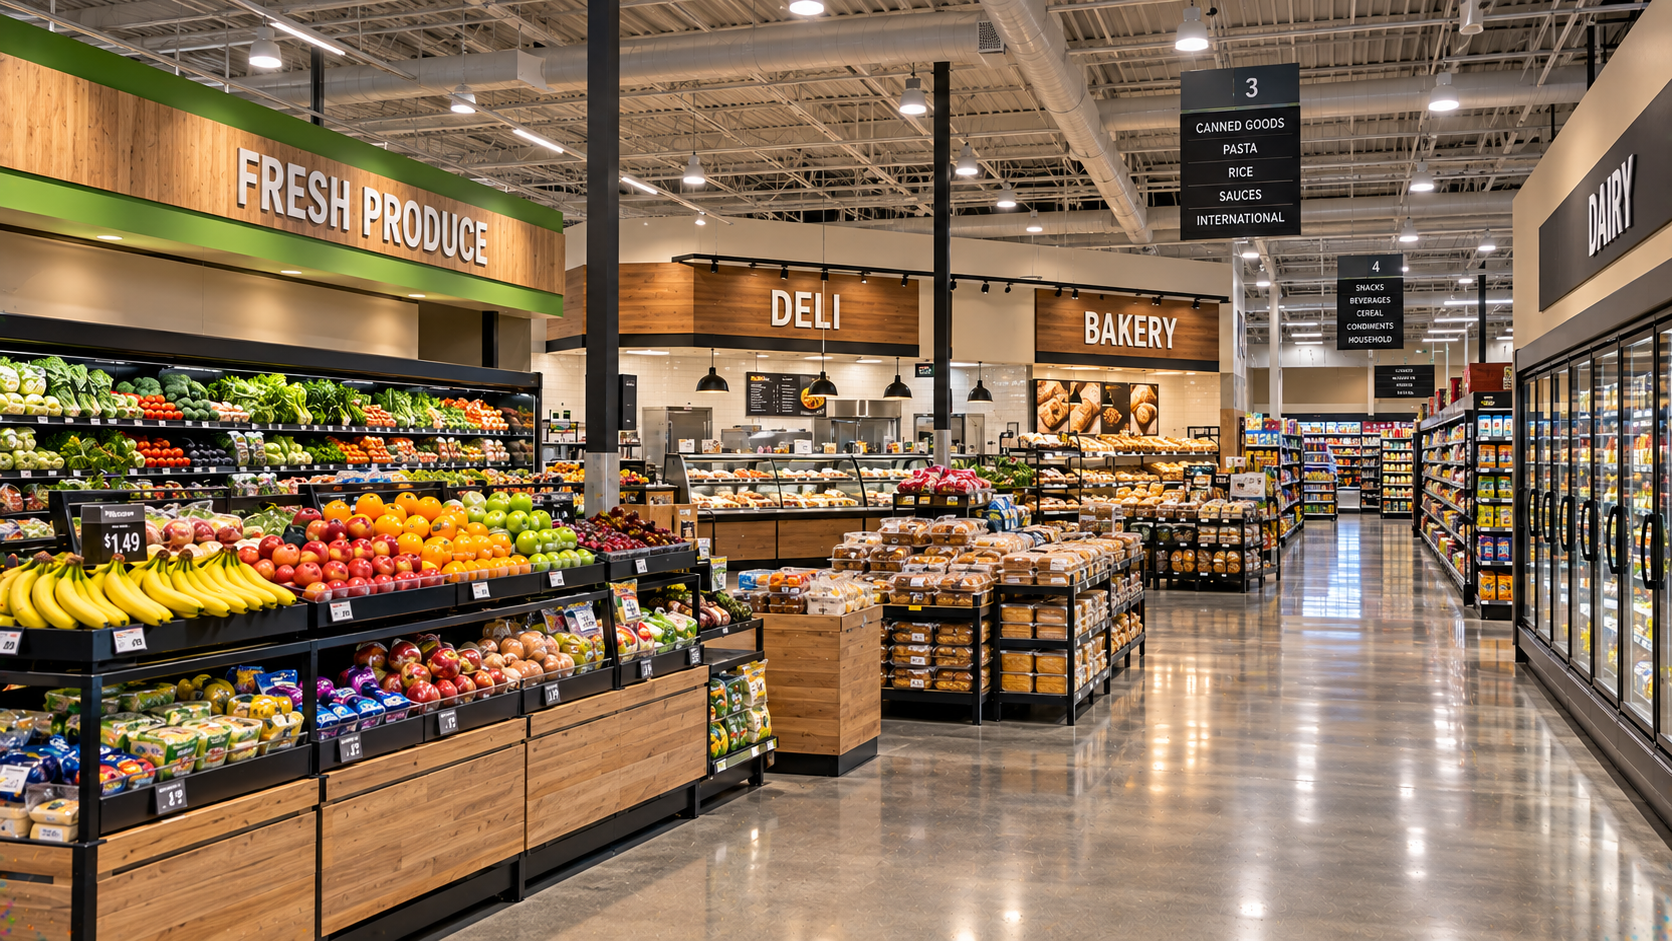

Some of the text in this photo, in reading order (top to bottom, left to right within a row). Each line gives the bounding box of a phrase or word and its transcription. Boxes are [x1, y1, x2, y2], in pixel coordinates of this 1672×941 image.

[1245, 77, 1259, 98] 3
[1195, 117, 1285, 134] CANNED GOODS
[1223, 142, 1258, 155] PASTA
[1228, 166, 1254, 178] RICE
[1219, 188, 1262, 202] SAUCES
[237, 147, 489, 266] FRESH PRODUCE
[1588, 154, 1637, 257] DAIRY
[1196, 211, 1285, 226] INTERNATIONAL
[1371, 260, 1381, 273] 4
[1349, 296, 1391, 305] BEVERAGES
[771, 289, 840, 330] DELI
[1356, 309, 1384, 318] CEREAL
[1084, 311, 1178, 349] BAKERY
[1346, 321, 1394, 331] CONDIMENTS
[1348, 335, 1393, 344] HOUSEHOLD
[104, 532, 140, 554] $1.49
